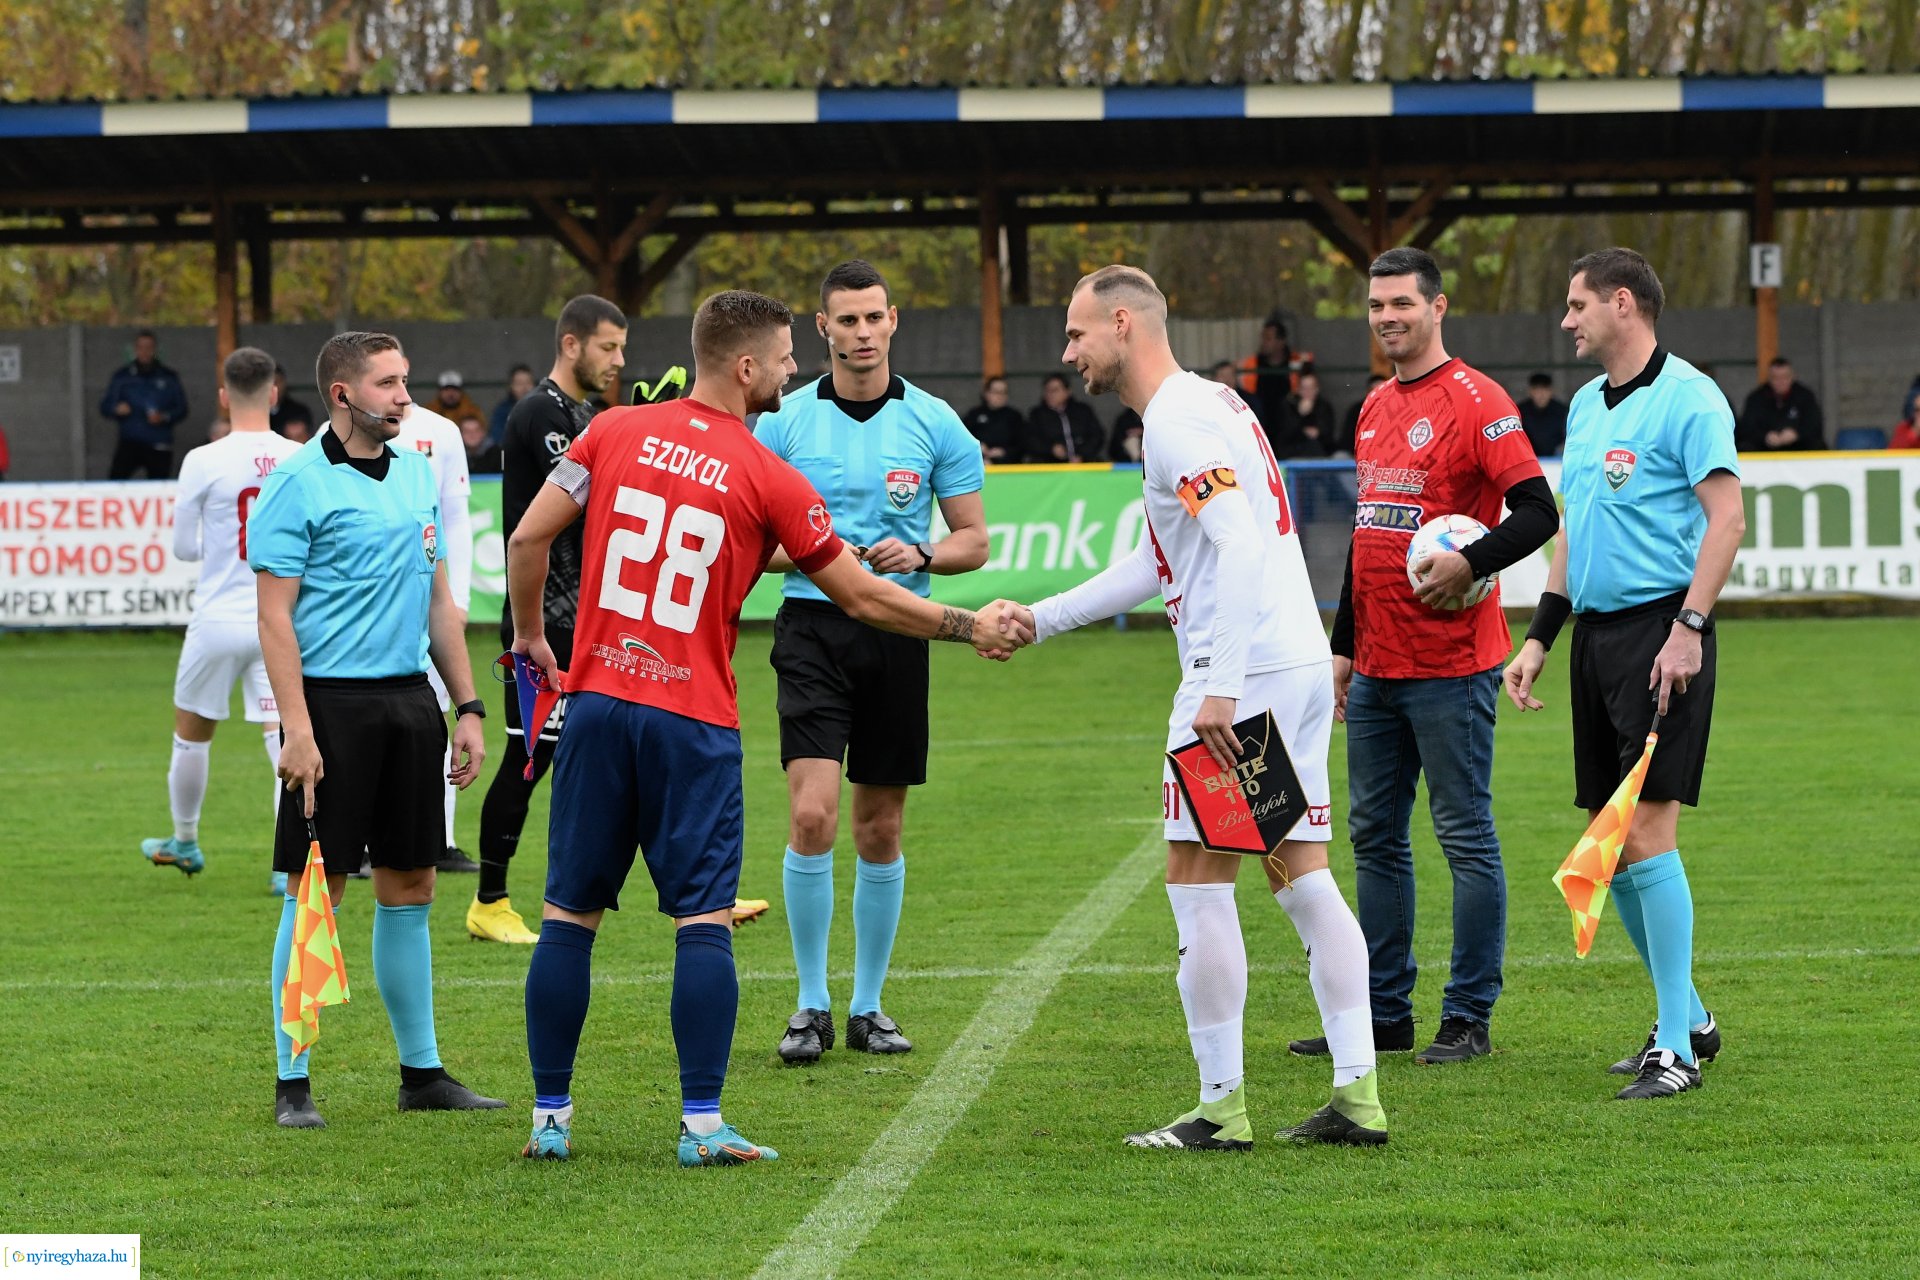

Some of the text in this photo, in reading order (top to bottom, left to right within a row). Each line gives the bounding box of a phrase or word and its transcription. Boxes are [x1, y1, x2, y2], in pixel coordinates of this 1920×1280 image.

[1760, 249, 1774, 282] F
[1485, 418, 1522, 439] TiPP
[637, 436, 730, 493] SZOKOL
[1610, 453, 1630, 461] MLSZ
[894, 473, 915, 482] MLSZ
[1211, 467, 1237, 488] C
[1252, 421, 1298, 537] 9
[1356, 505, 1417, 529] PPMIX
[1740, 468, 1920, 548] ml
[931, 498, 1104, 572] ank
[0, 532, 165, 577] TÓMOSÓ
[598, 485, 725, 635] 28
[1730, 563, 1861, 592] Magyar
[640, 657, 691, 680] TRANS
[1202, 757, 1268, 794] BMTE
[1224, 780, 1260, 805] 110
[1163, 781, 1180, 820] 91
[1216, 790, 1289, 832] Budafok
